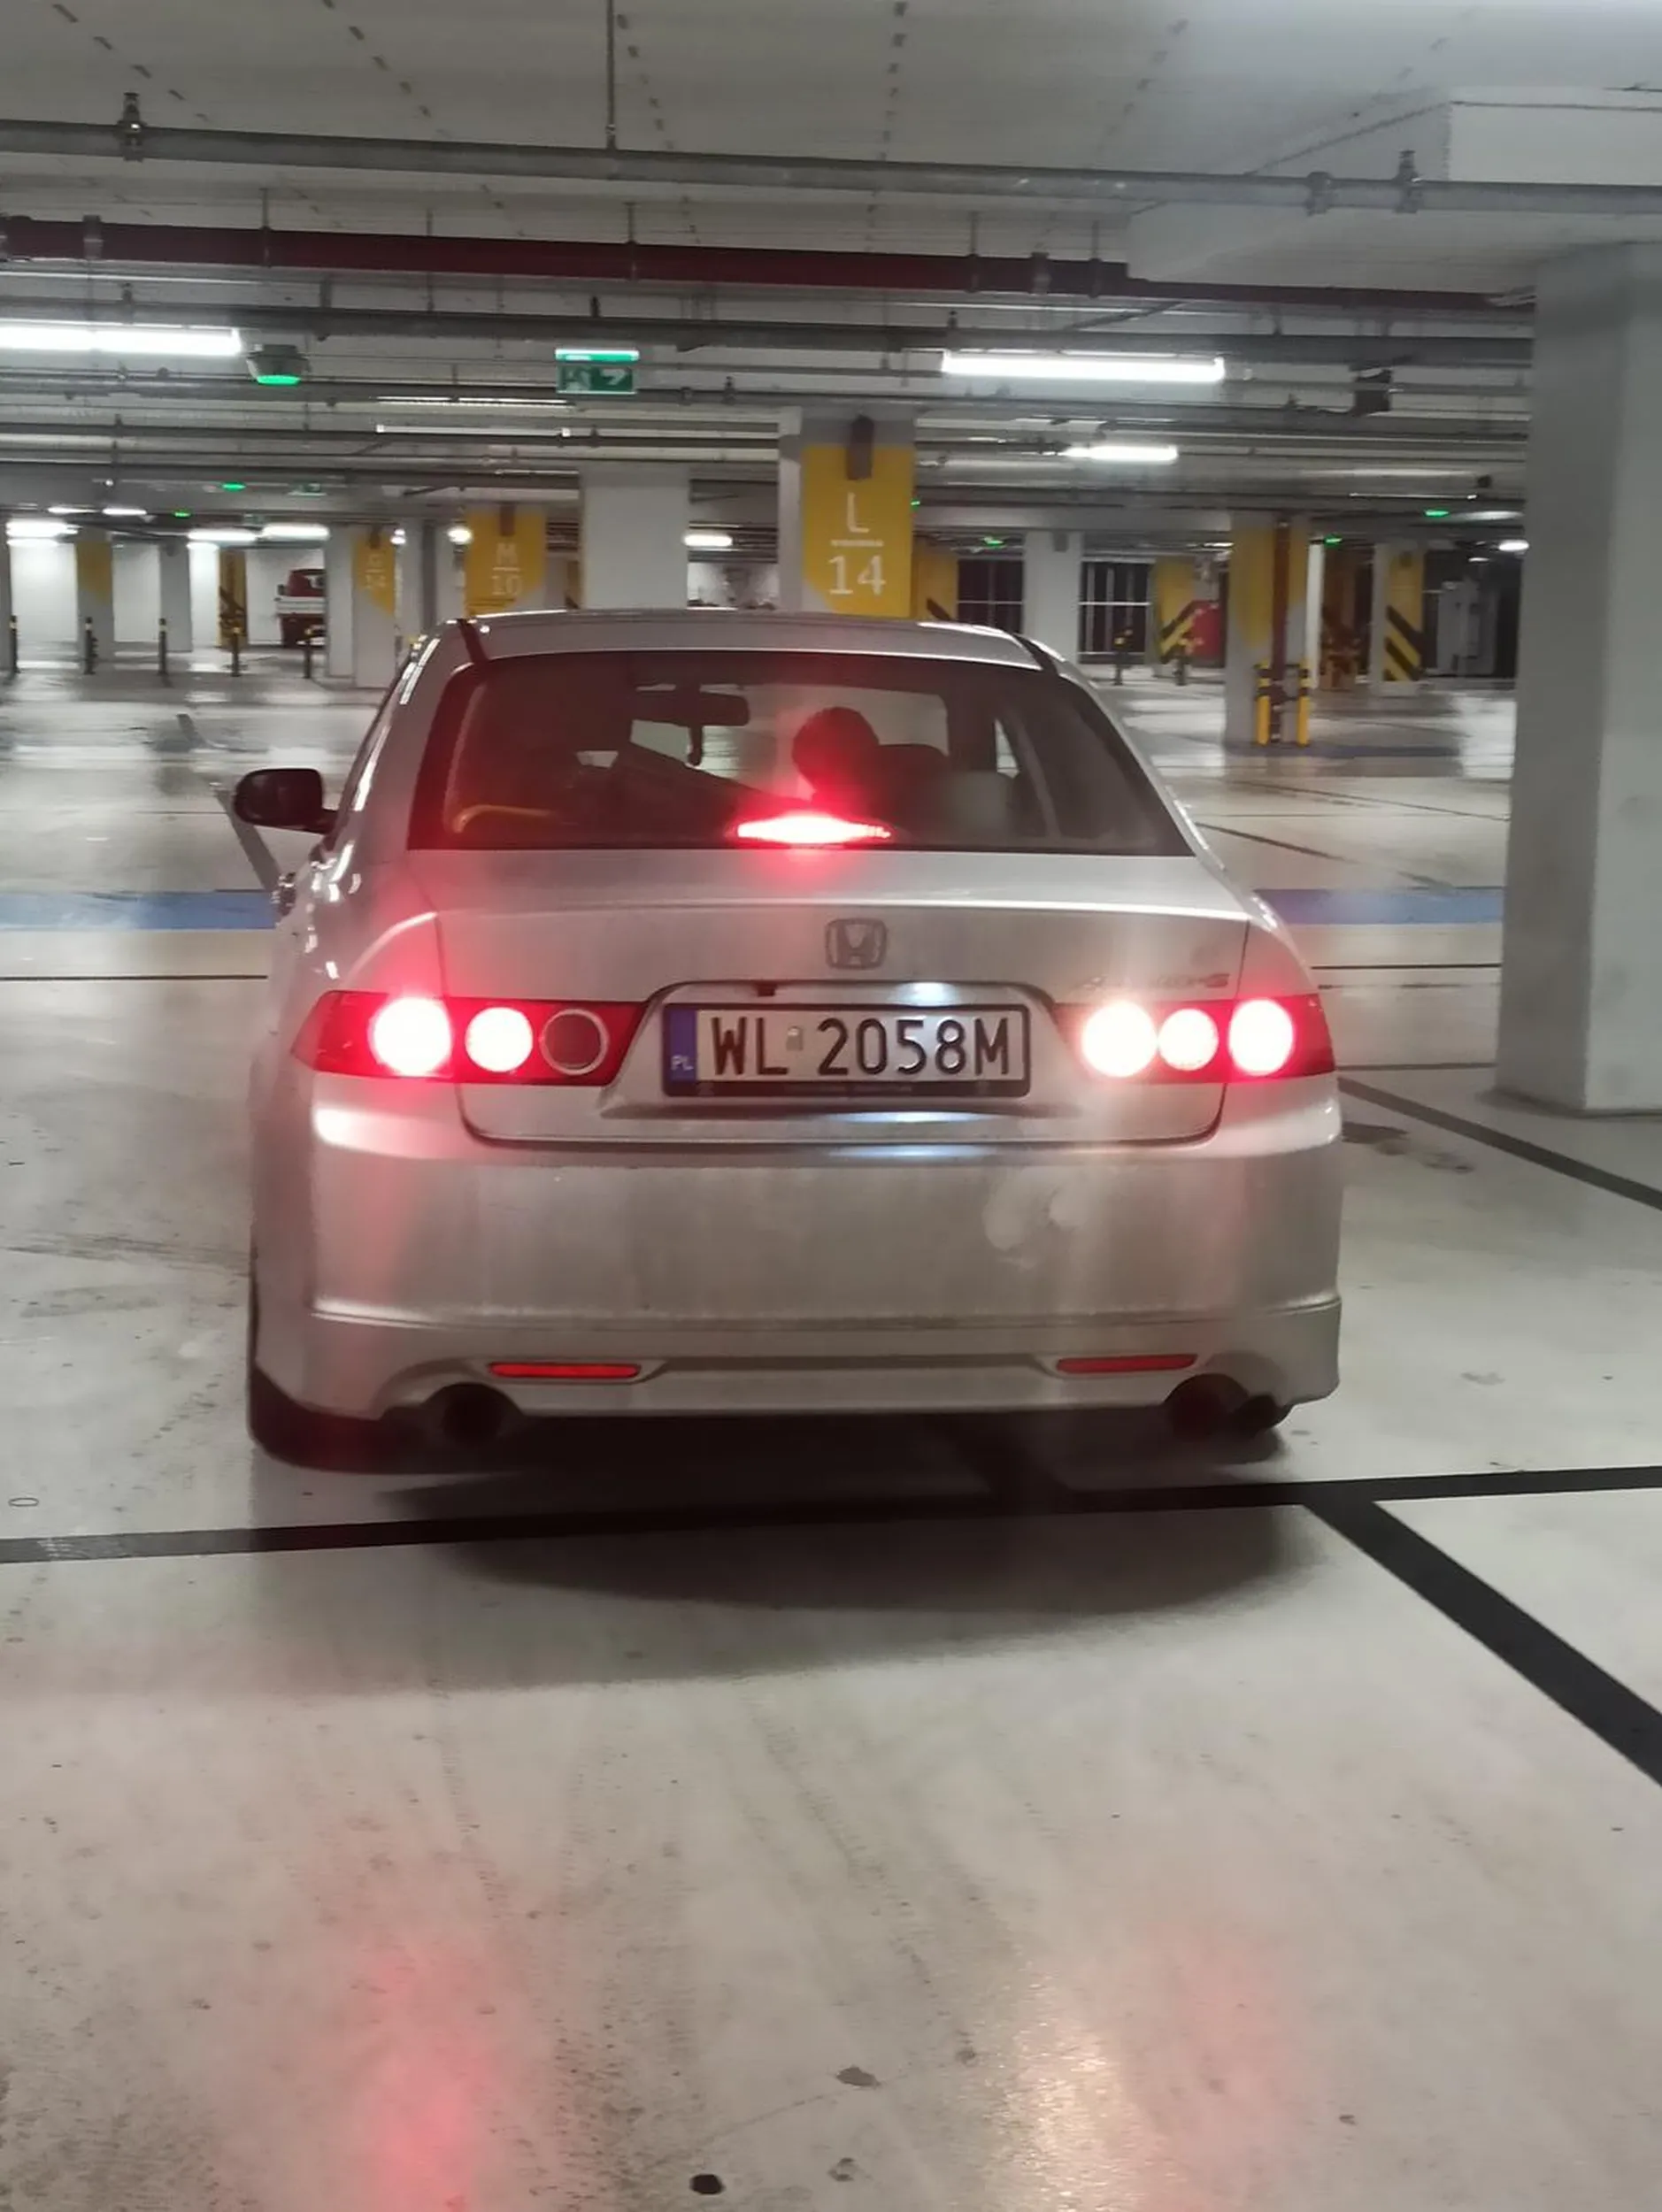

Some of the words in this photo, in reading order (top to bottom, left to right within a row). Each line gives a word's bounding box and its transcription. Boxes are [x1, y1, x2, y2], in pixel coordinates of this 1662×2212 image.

[846, 492, 870, 533] L
[828, 555, 887, 595] 14
[670, 1056, 695, 1071] PL
[712, 1017, 789, 1075] WL
[817, 1017, 1010, 1076] 2058M
